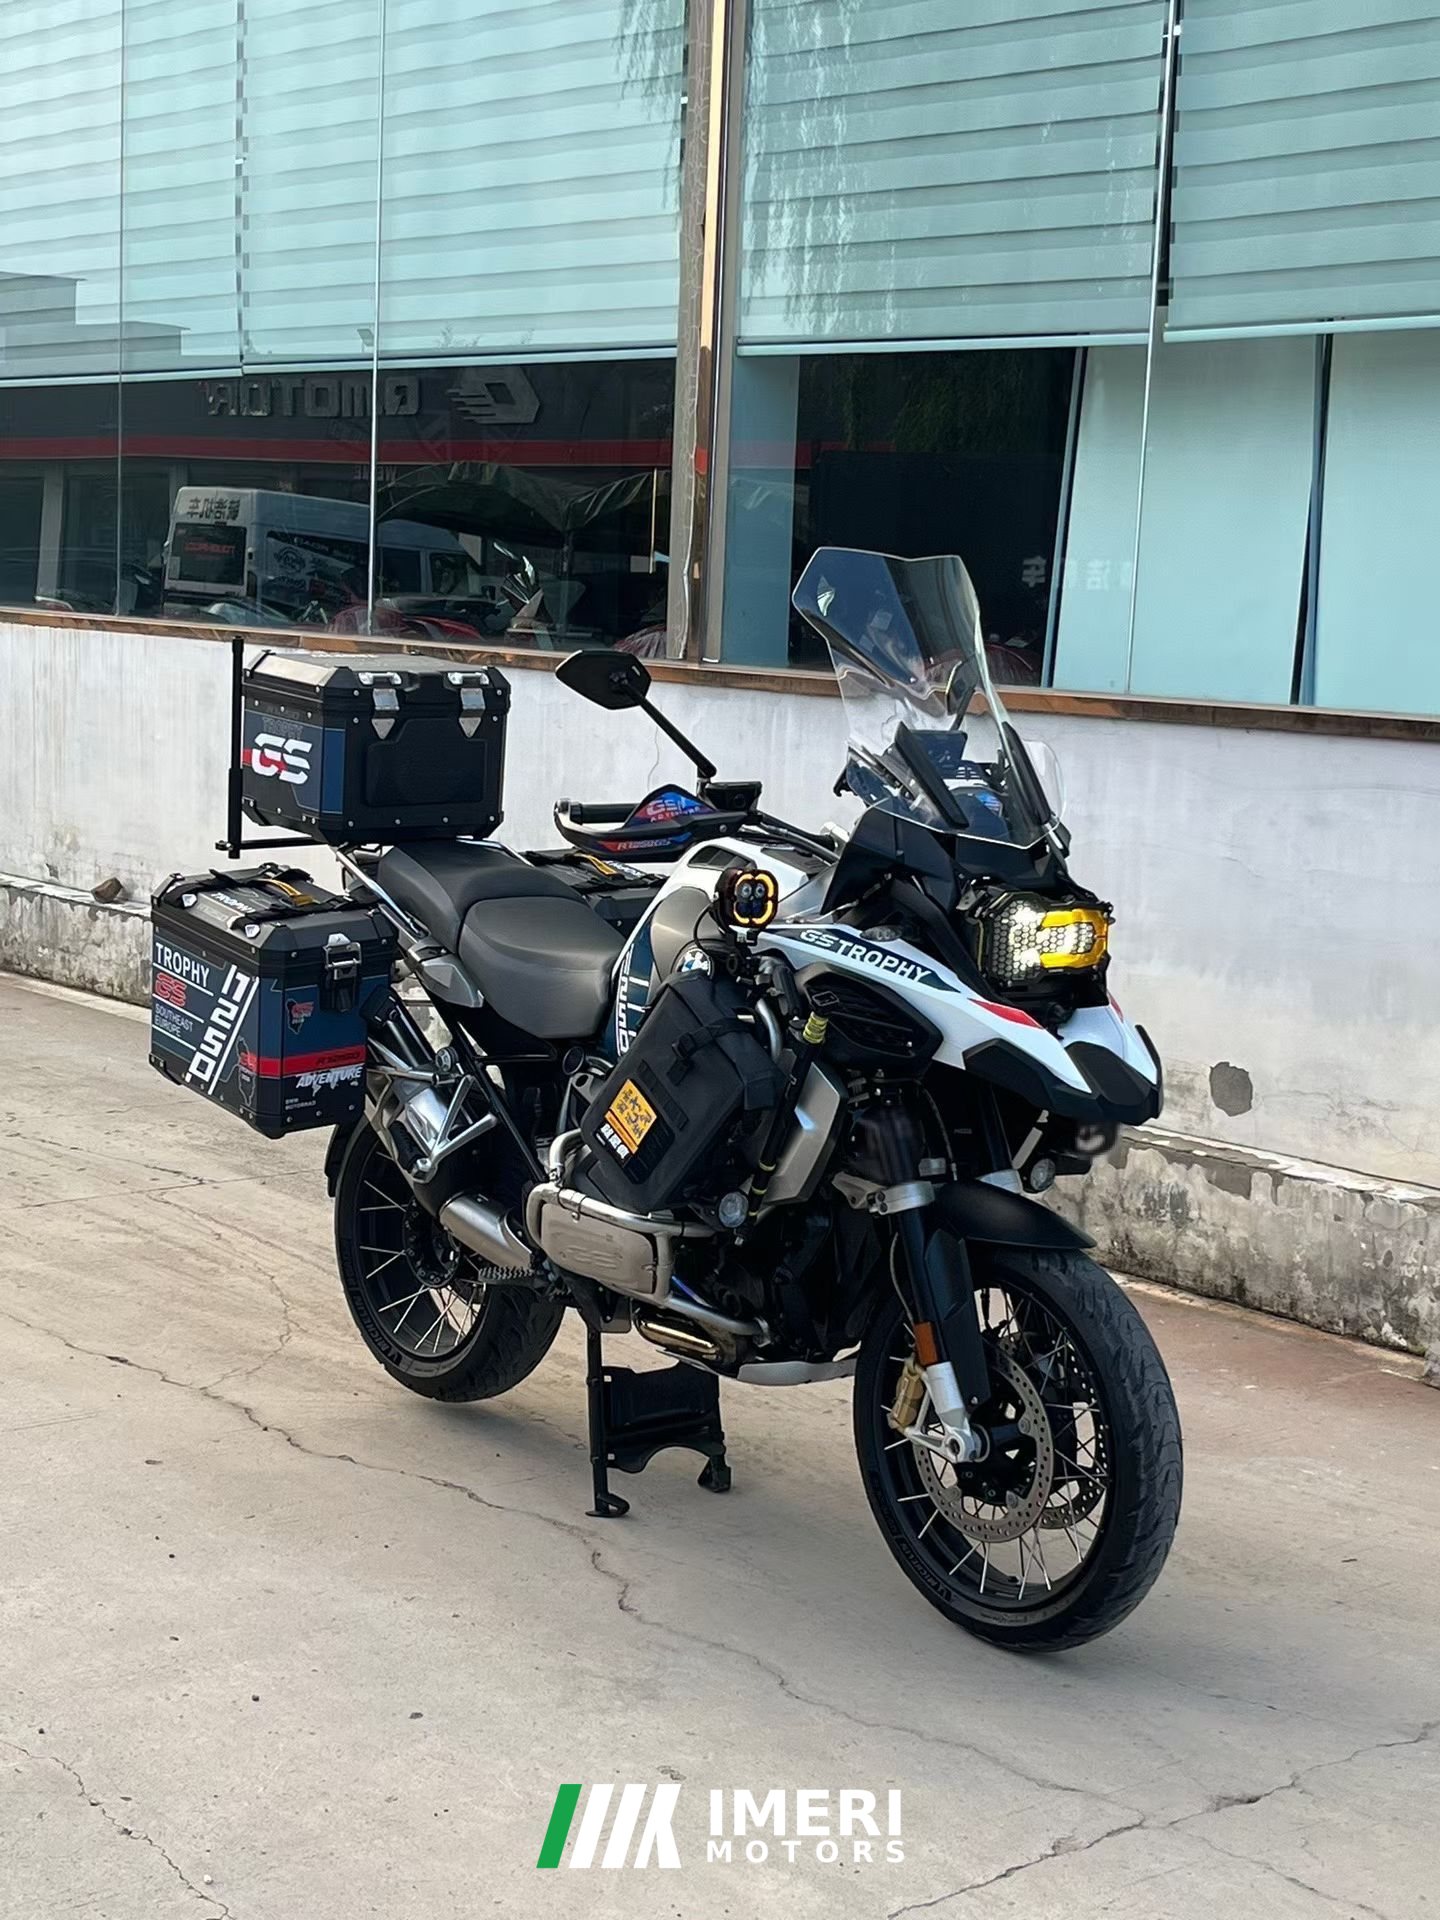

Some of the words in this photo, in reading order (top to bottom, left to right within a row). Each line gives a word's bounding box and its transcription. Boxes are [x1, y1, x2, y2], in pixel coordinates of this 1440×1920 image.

[251, 733, 312, 785] GS
[155, 942, 210, 988] TROPHY
[801, 929, 839, 948] GS
[834, 940, 932, 982] TROPHY
[154, 1014, 182, 1038] EUROPE
[155, 1003, 194, 1033] SOUTHEAST
